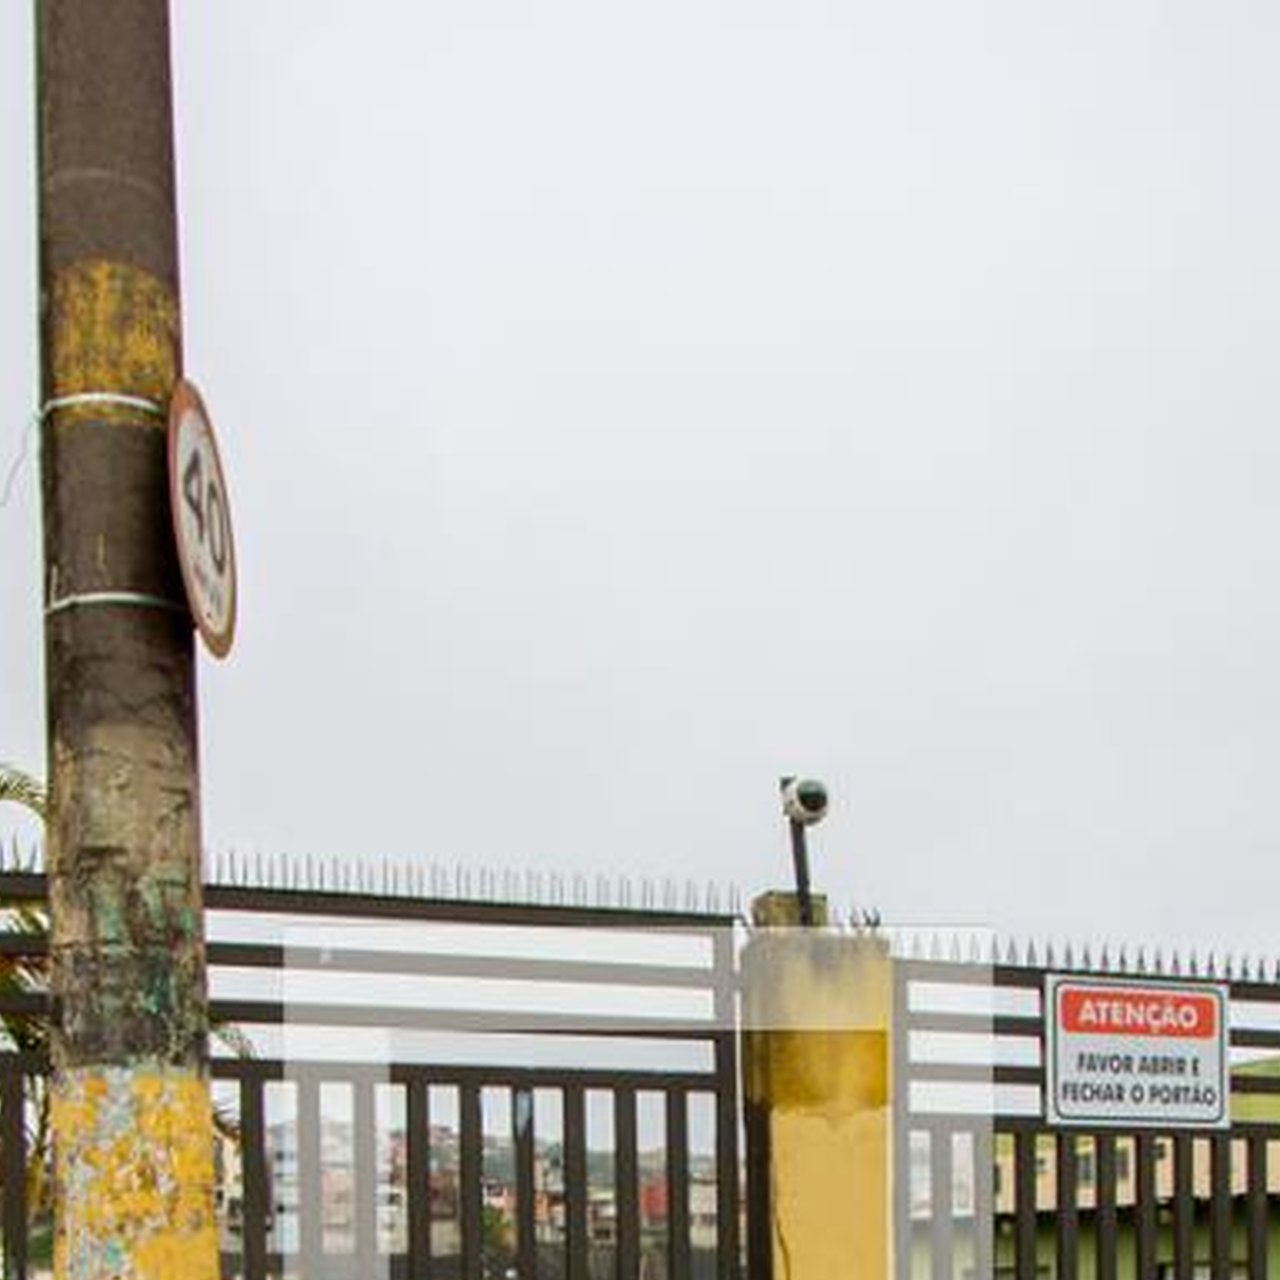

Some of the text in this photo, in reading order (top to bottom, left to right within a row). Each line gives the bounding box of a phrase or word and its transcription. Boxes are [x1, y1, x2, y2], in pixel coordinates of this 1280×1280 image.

[183, 448, 225, 576] 40
[1078, 997, 1198, 1033] ATENÇÃO
[1077, 1052, 1200, 1076] FAVOR ABRIR E
[1062, 1081, 1217, 1107] FECHAR O PORTÃO
